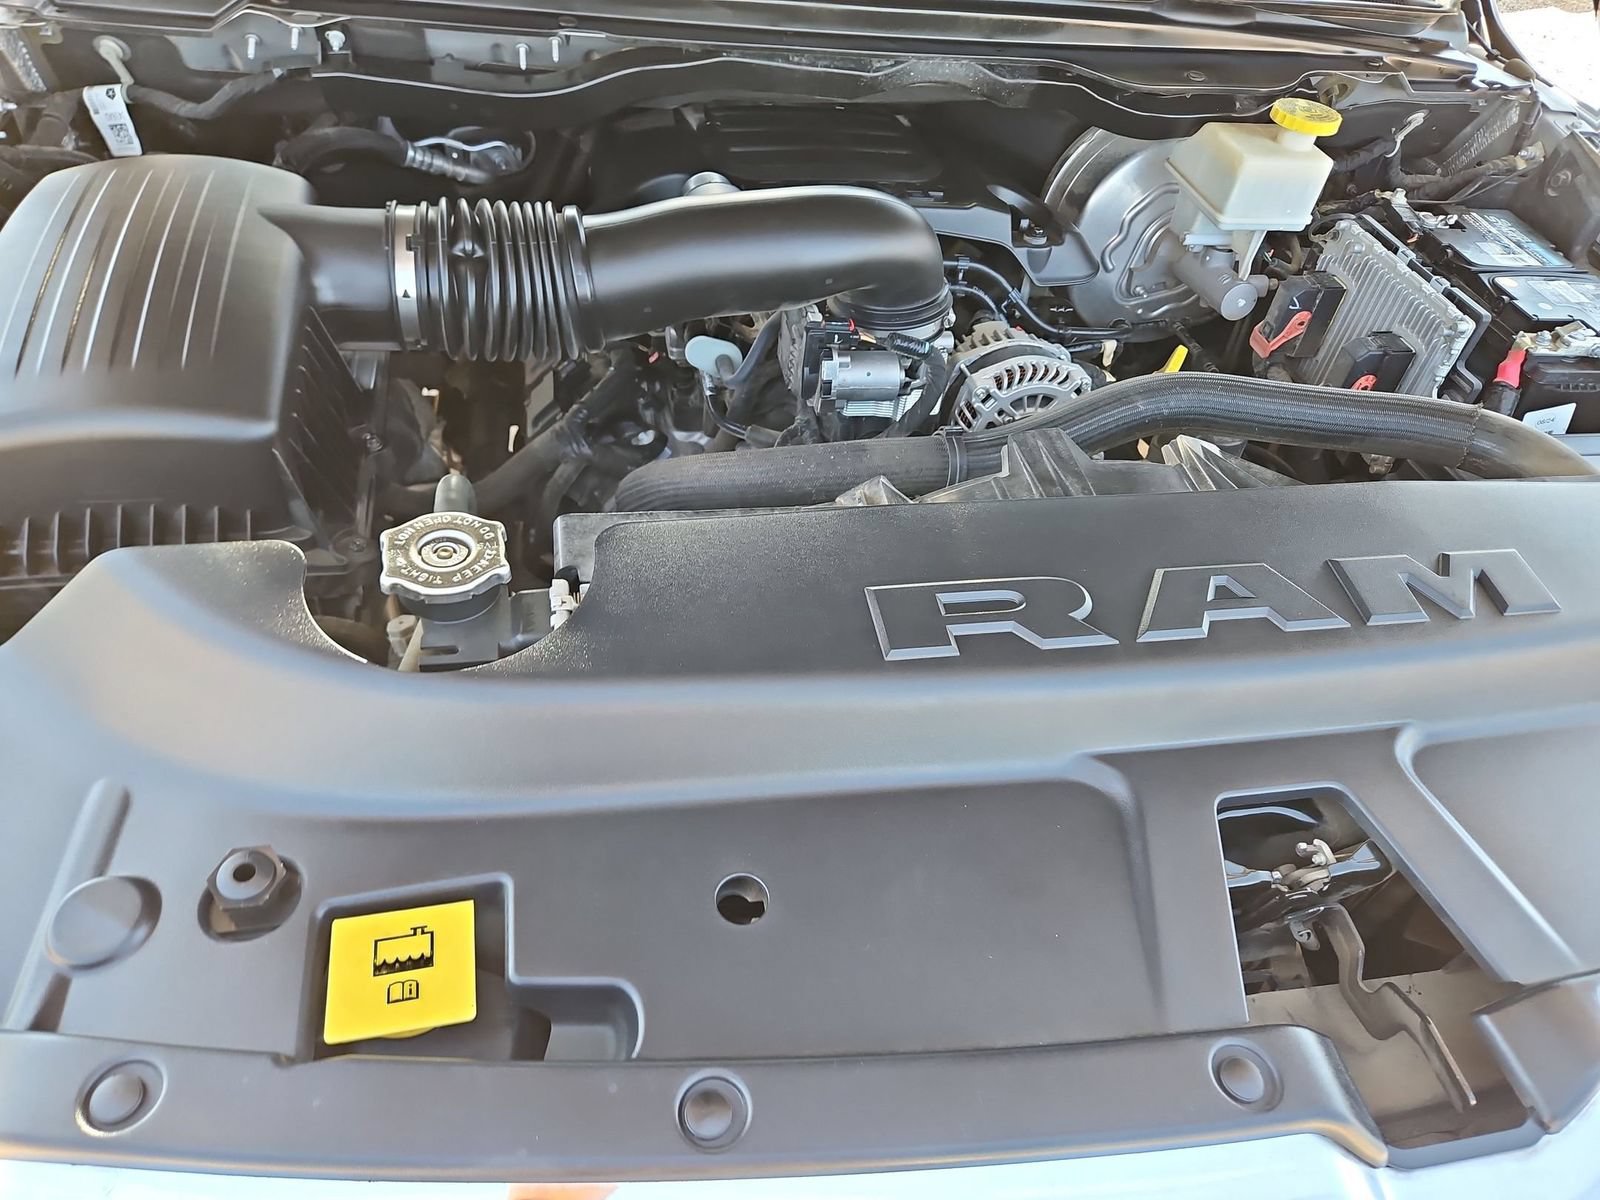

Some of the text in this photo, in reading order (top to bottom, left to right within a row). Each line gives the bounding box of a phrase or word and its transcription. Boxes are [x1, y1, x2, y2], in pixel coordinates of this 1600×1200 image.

[415, 515, 453, 531] OPEN
[453, 515, 482, 529] NOT
[394, 526, 416, 546] HOT
[480, 526, 495, 540] DO
[400, 560, 490, 585] KEEP TIGHT
[864, 548, 1562, 662] RAM
